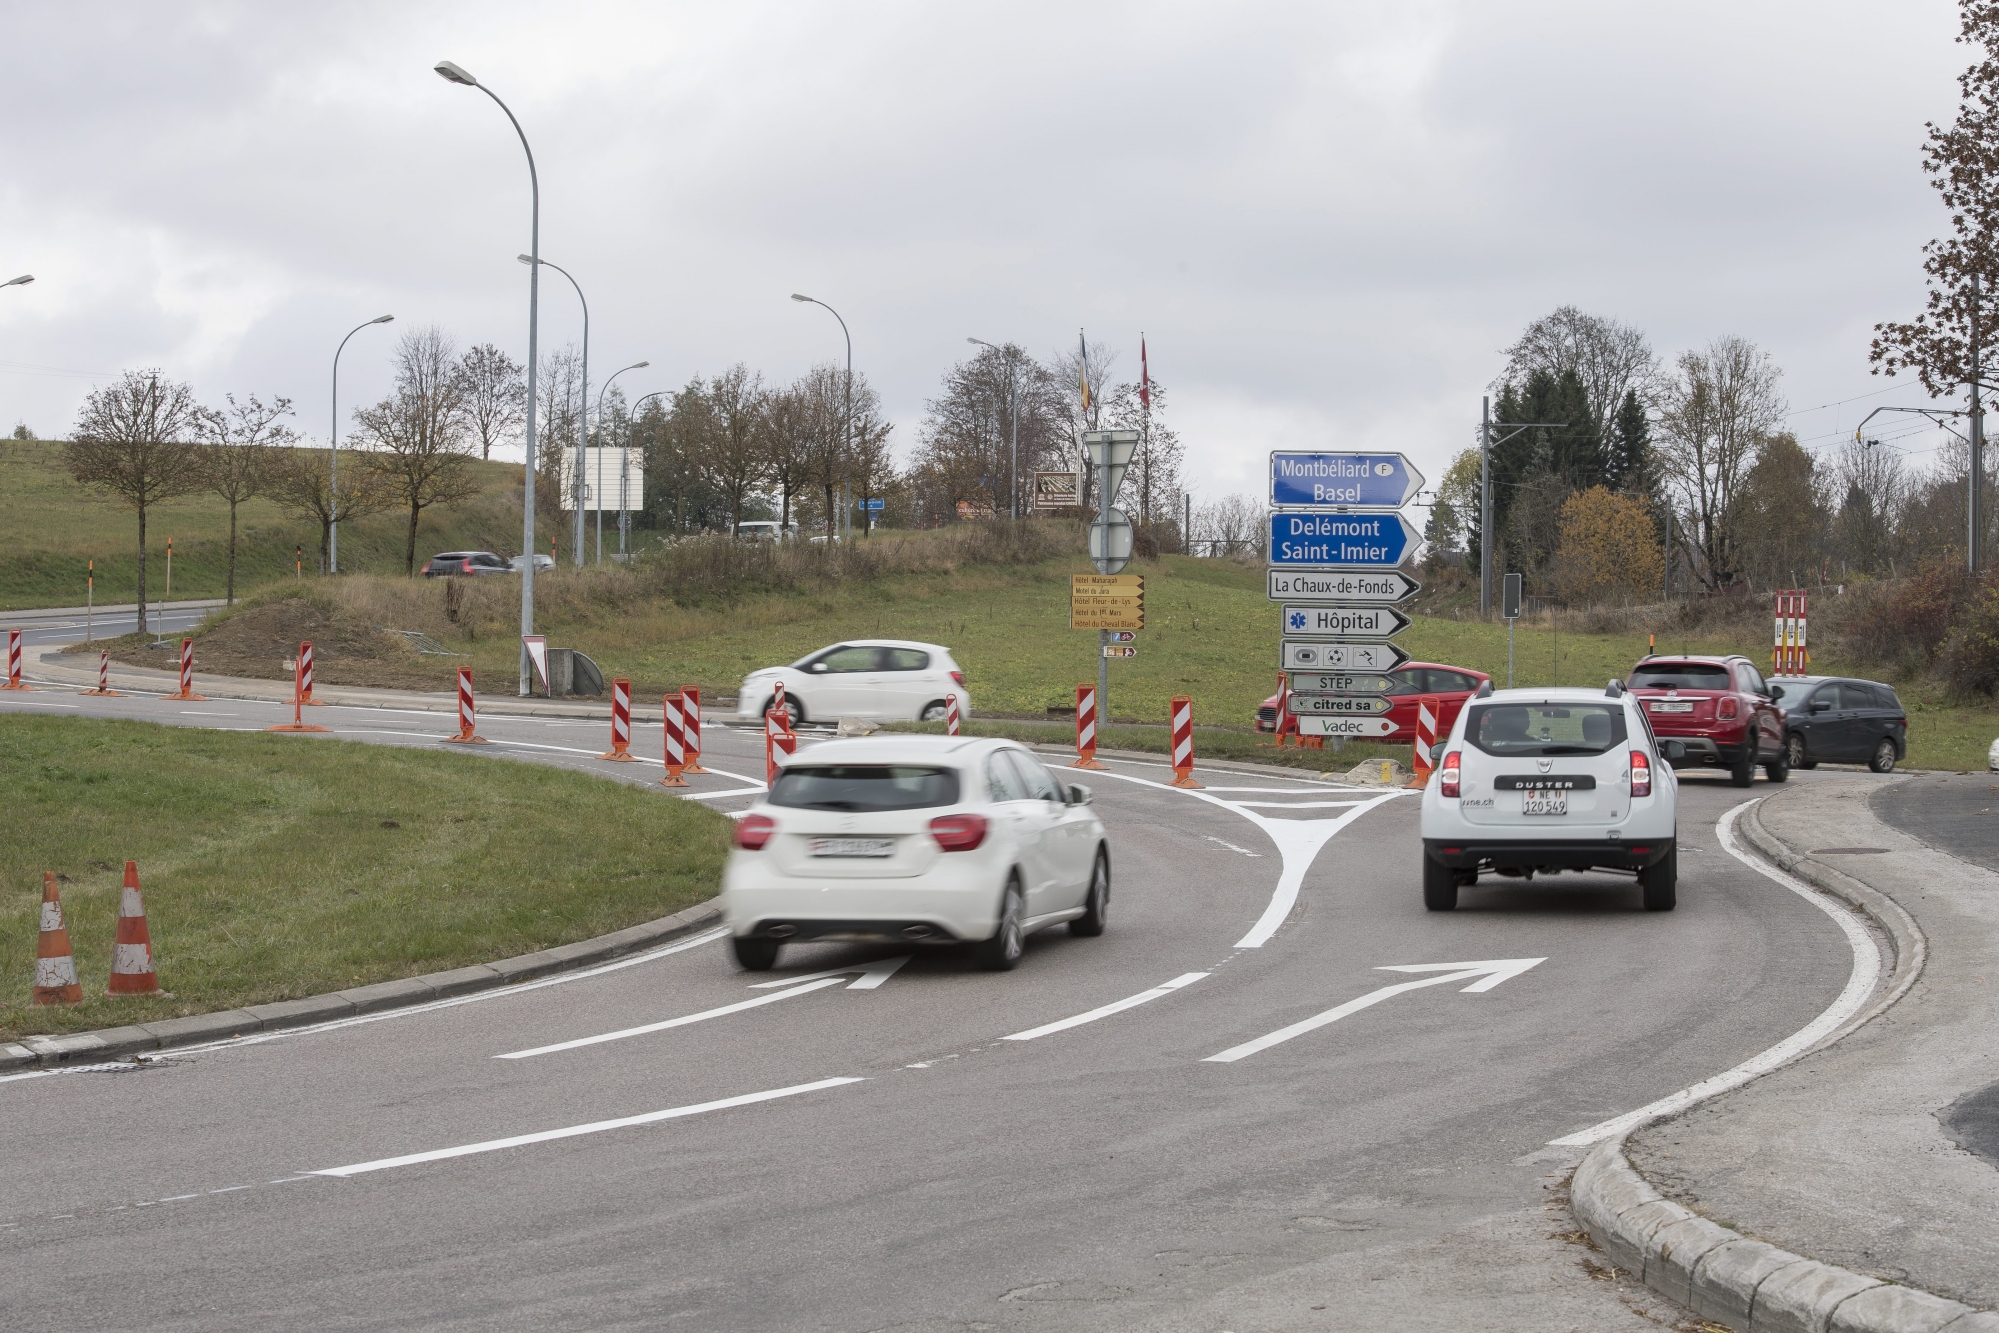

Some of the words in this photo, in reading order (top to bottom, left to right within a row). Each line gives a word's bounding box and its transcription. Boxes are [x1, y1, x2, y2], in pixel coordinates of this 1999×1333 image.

[1281, 459, 1370, 478] Montbéliard
[1381, 464, 1387, 474] F
[1314, 484, 1361, 502] Basel
[1290, 518, 1380, 536] Delémont
[1282, 542, 1388, 560] Saint-Imier
[1092, 577, 1118, 585] Maharajah
[1276, 578, 1288, 592] La
[1293, 577, 1394, 594] Chaux-de-Fonds
[1317, 612, 1378, 633] Hôpital
[1320, 677, 1352, 689] STEP
[1314, 699, 1352, 710] citred
[1356, 702, 1371, 710] sa
[1322, 720, 1363, 732] Vadec
[1539, 790, 1550, 799] NE
[1525, 801, 1544, 813] 120
[1546, 801, 1565, 813] 549
